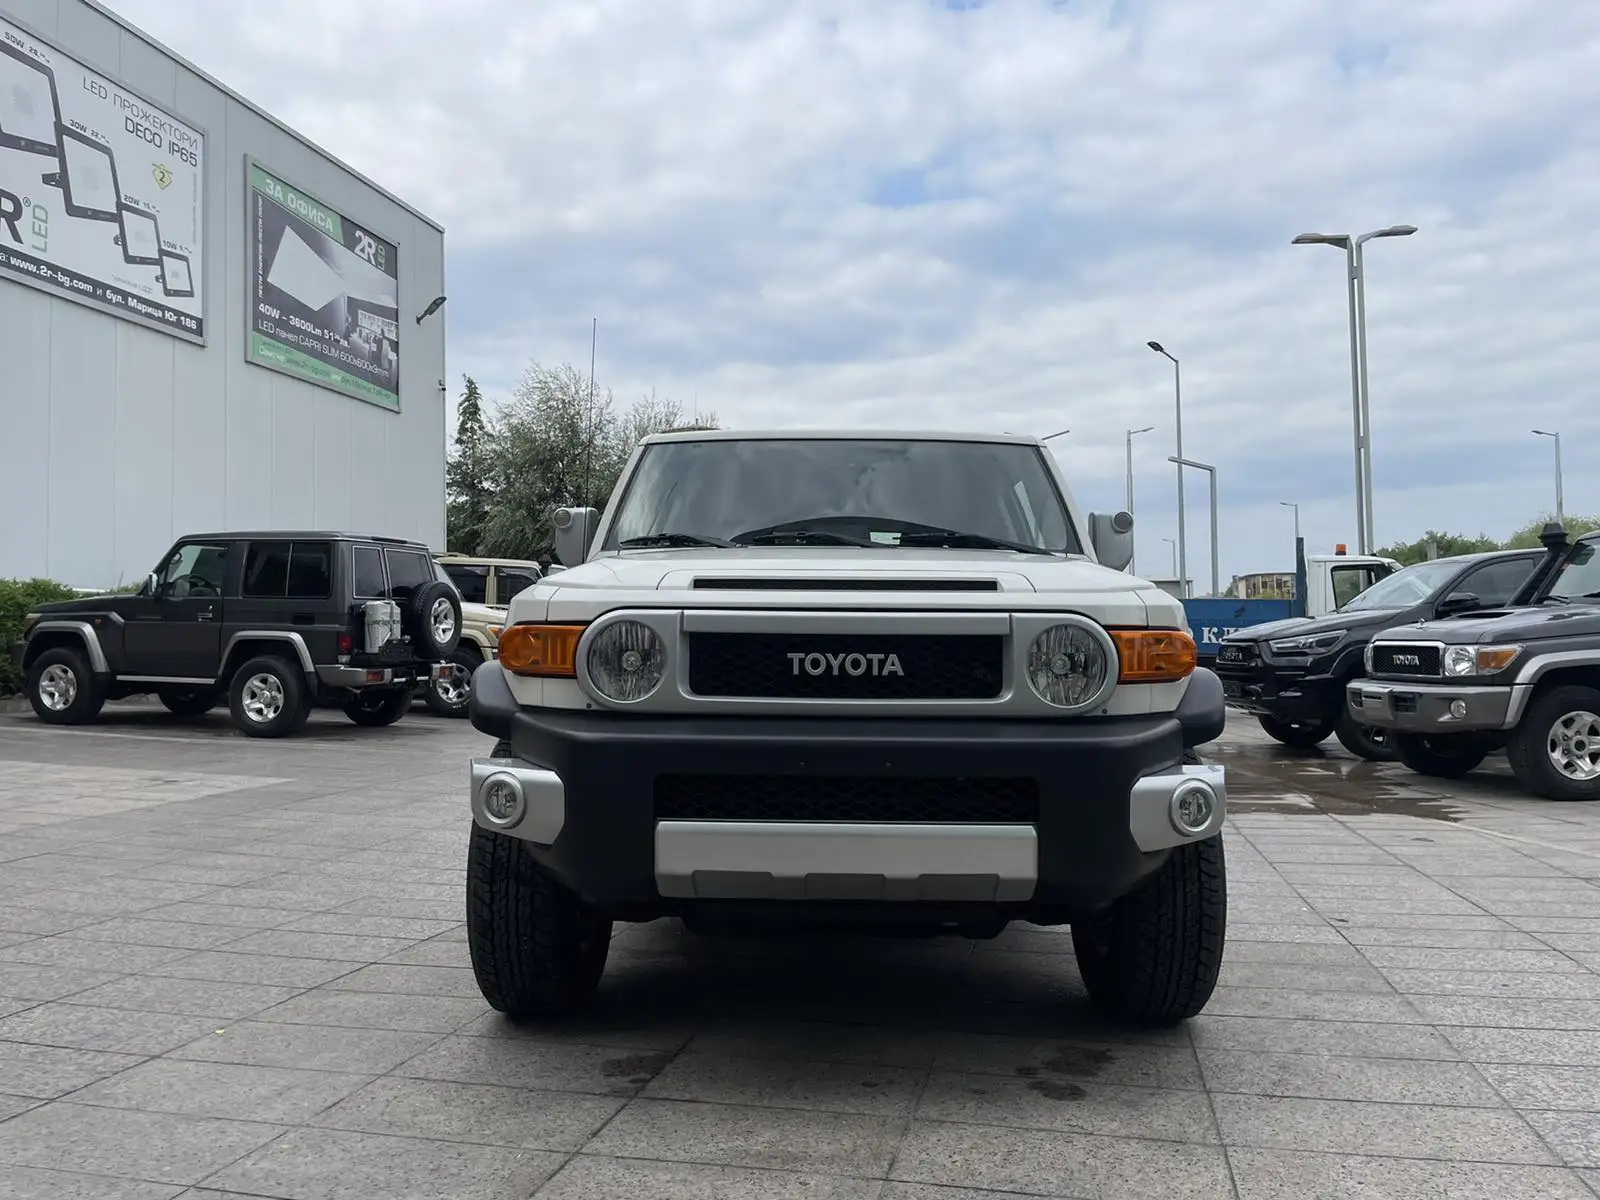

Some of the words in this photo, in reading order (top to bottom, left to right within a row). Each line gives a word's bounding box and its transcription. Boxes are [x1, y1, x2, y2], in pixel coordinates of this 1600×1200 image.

[70, 119, 87, 133] 30W
[83, 76, 108, 100] LED
[113, 95, 198, 151] ПРОЖЕКТОРИ
[124, 116, 162, 148] DECO
[168, 144, 198, 167] IP65
[265, 179, 284, 201] ЗА
[287, 193, 334, 233] ОФИСА
[32, 204, 48, 253] LED
[10, 256, 92, 292] www.2r-bg.com
[106, 290, 124, 304] бул.
[128, 296, 162, 318] Марица
[164, 310, 178, 322] Юг
[258, 303, 280, 319] 40W
[258, 319, 275, 334] LED
[298, 335, 322, 352] CAPRI
[786, 652, 904, 676] TOYOTA
[1392, 655, 1420, 666] TOYOTA
